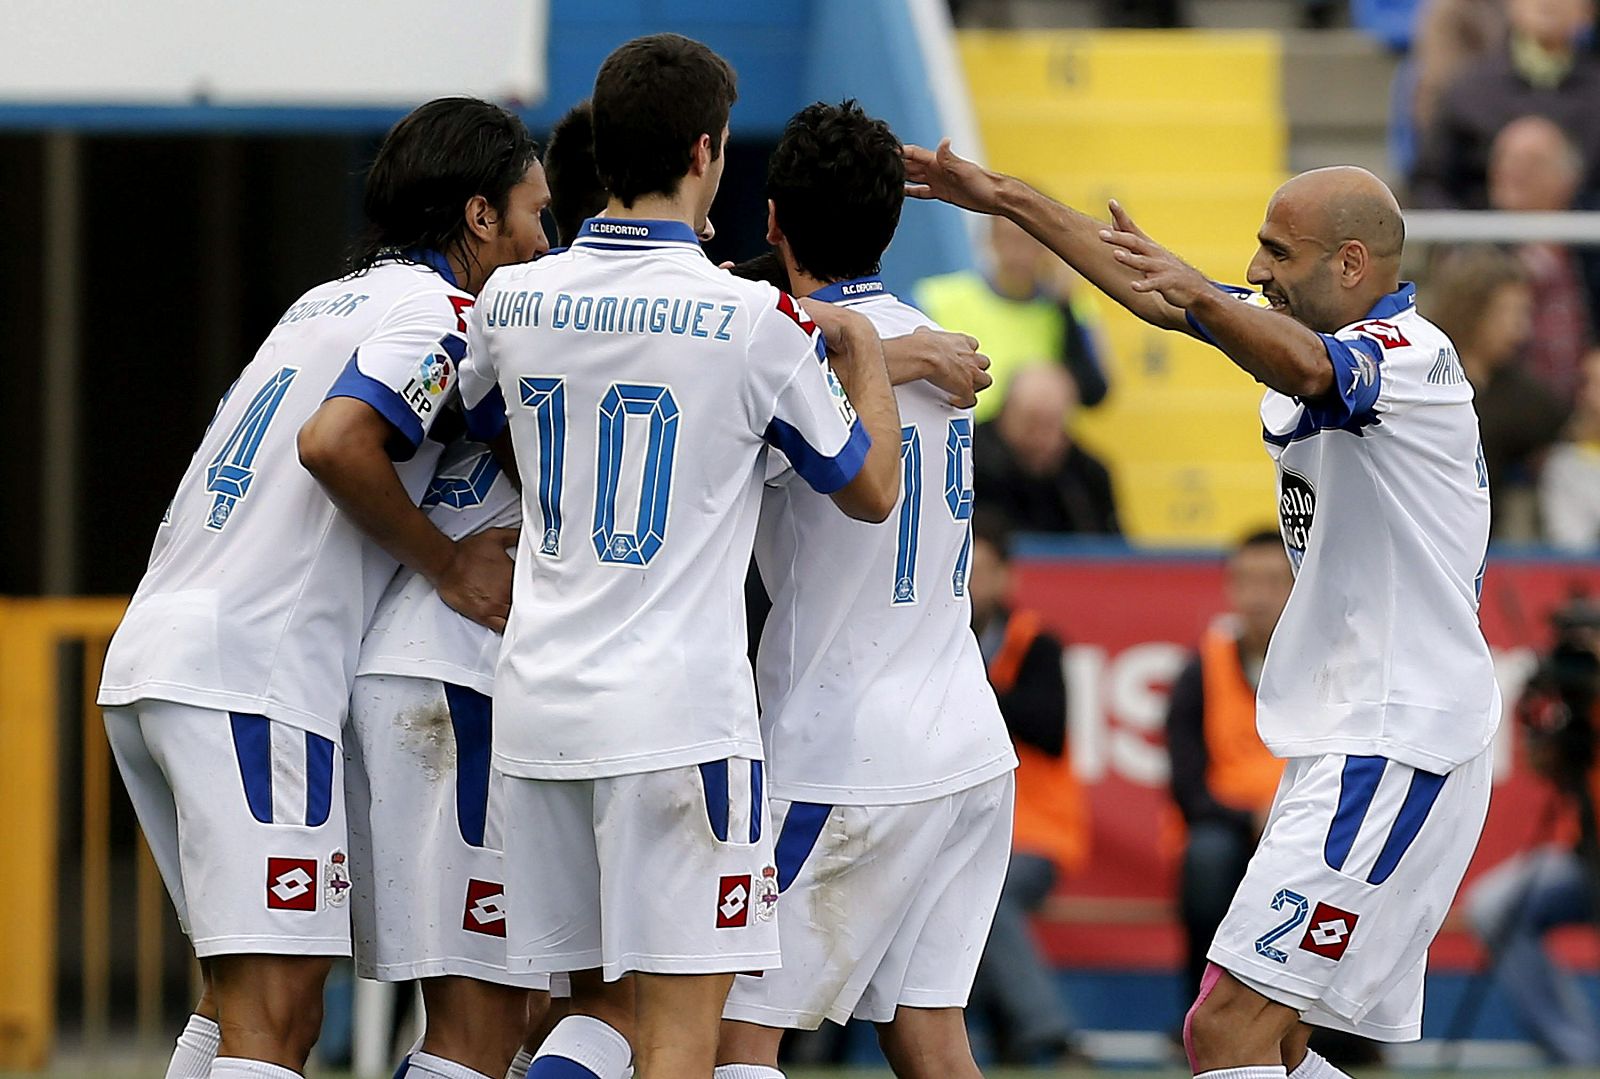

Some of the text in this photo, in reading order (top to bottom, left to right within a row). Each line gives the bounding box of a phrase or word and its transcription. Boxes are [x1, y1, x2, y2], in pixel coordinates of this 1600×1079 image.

[600, 223, 649, 237] DEPORTIVO
[487, 290, 737, 341] JUAN DOMINGUEZ
[402, 377, 432, 413] LFP
[197, 365, 302, 534] 4
[517, 374, 683, 570] 10
[889, 416, 974, 607] 19
[1253, 886, 1310, 965] 2
